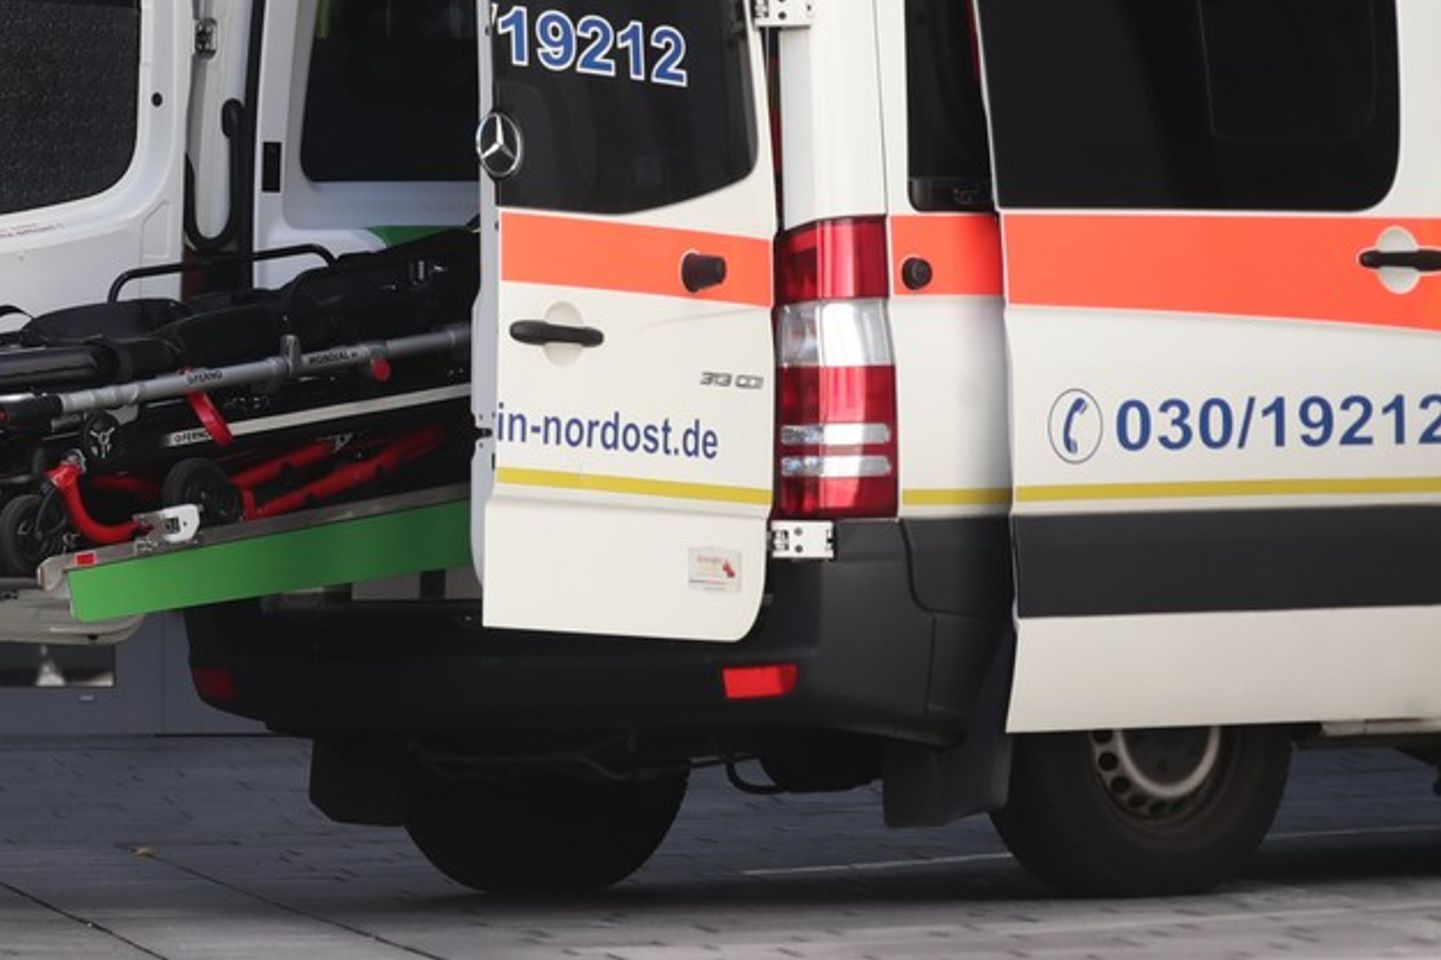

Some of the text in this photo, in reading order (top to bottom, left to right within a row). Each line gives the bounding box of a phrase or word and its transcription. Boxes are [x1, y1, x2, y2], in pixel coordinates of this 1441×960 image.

[490, 2, 688, 87] 19212
[496, 401, 719, 460] in-nordost.de
[1115, 394, 1441, 451] 030/19212
